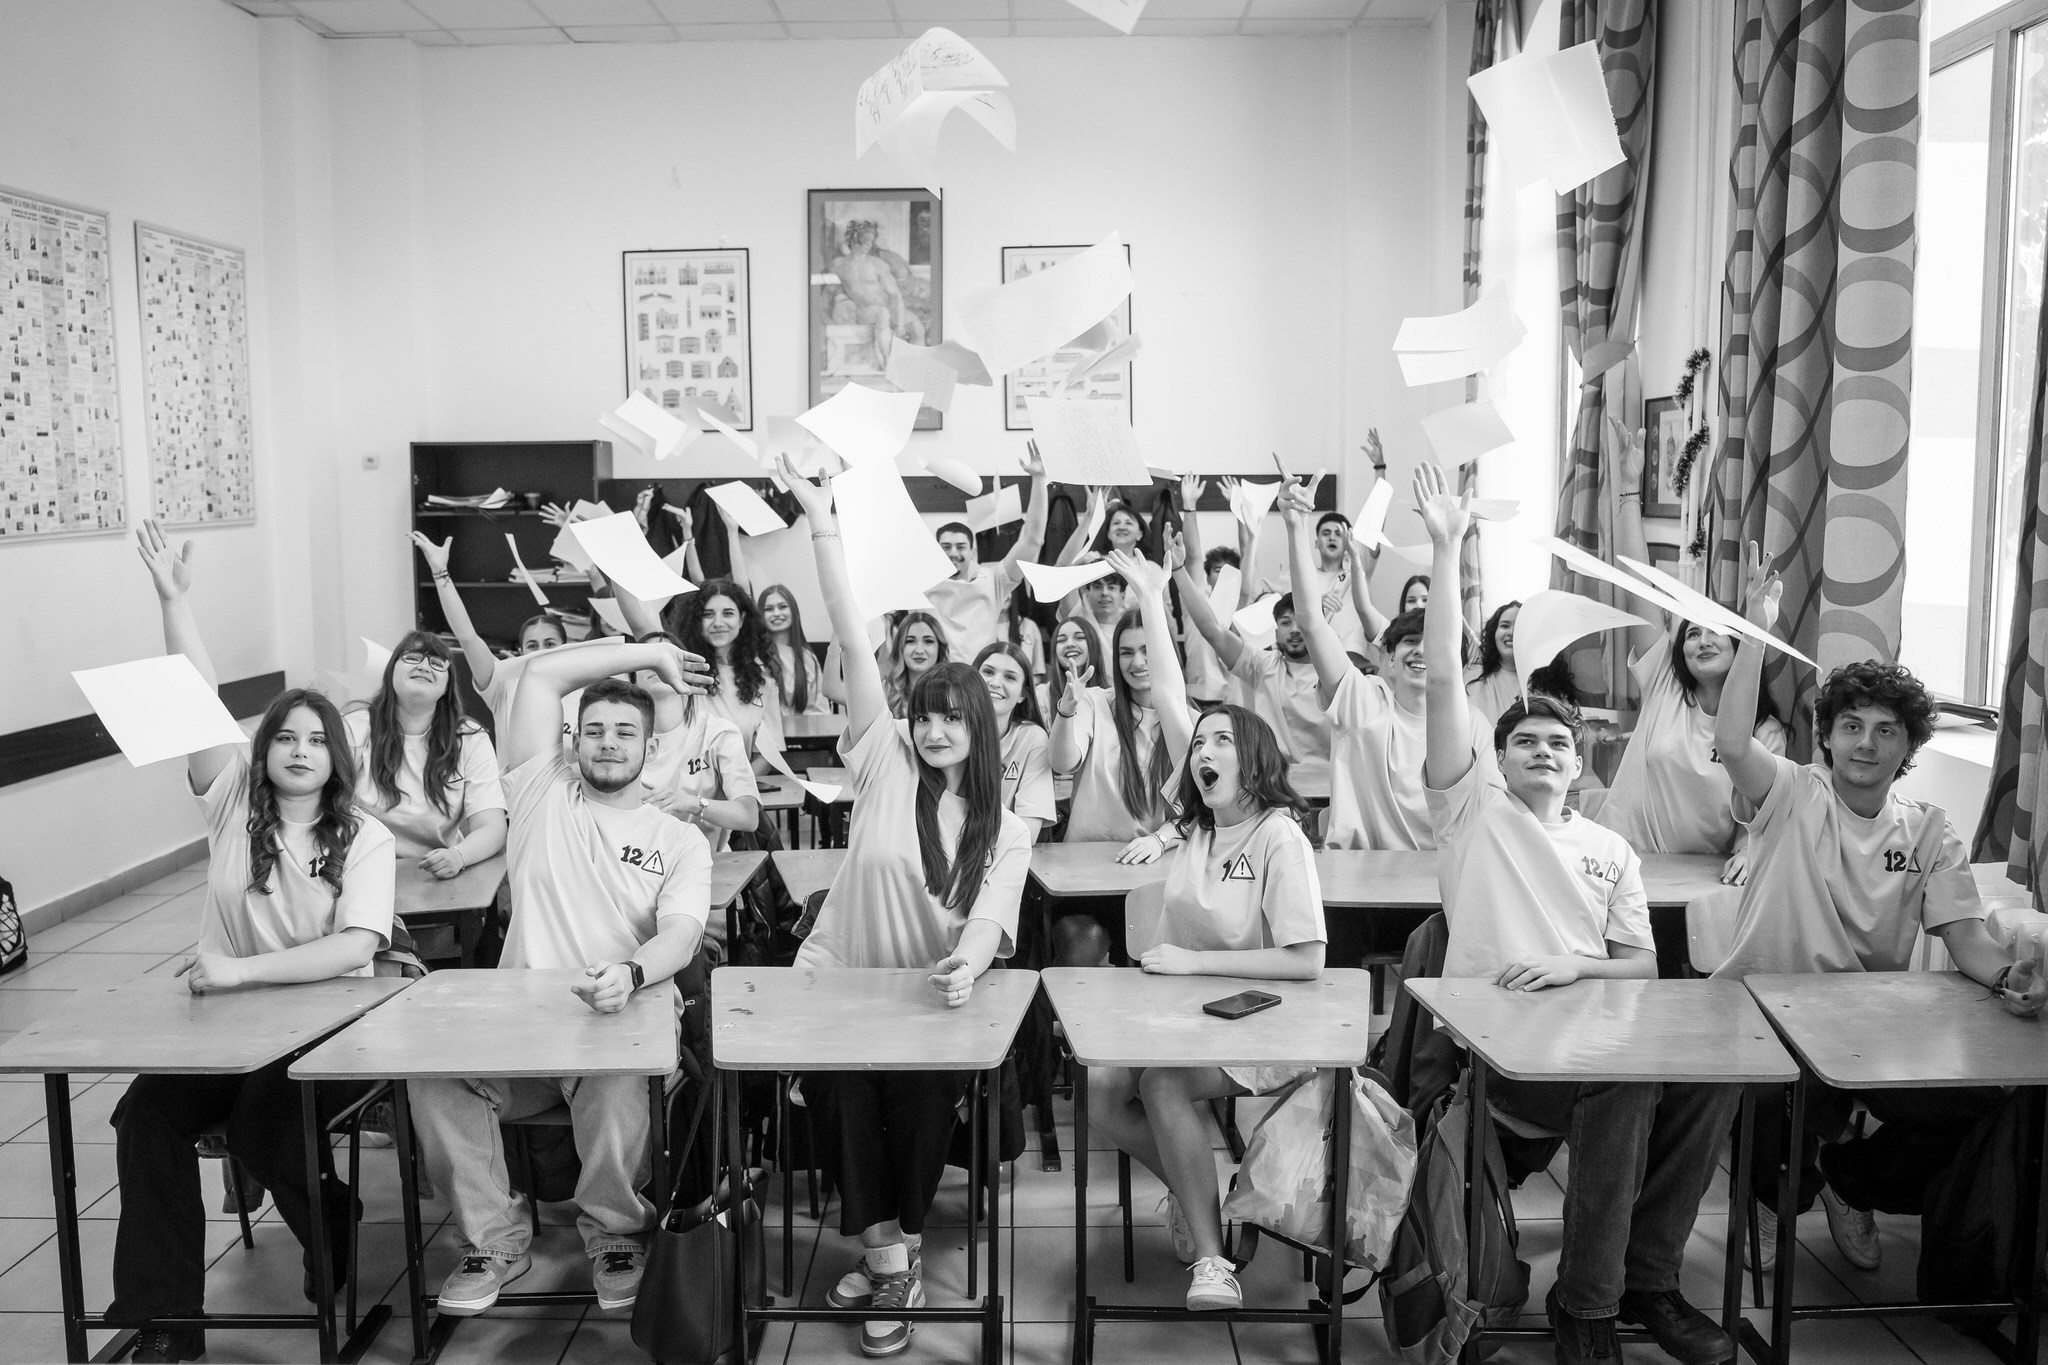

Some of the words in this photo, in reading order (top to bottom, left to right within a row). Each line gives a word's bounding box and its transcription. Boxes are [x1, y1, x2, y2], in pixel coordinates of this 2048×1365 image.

[563, 722, 572, 735] 2
[620, 845, 644, 866] 12
[1580, 855, 1603, 878] 12
[1883, 848, 1907, 872] 12
[308, 856, 329, 878] 12
